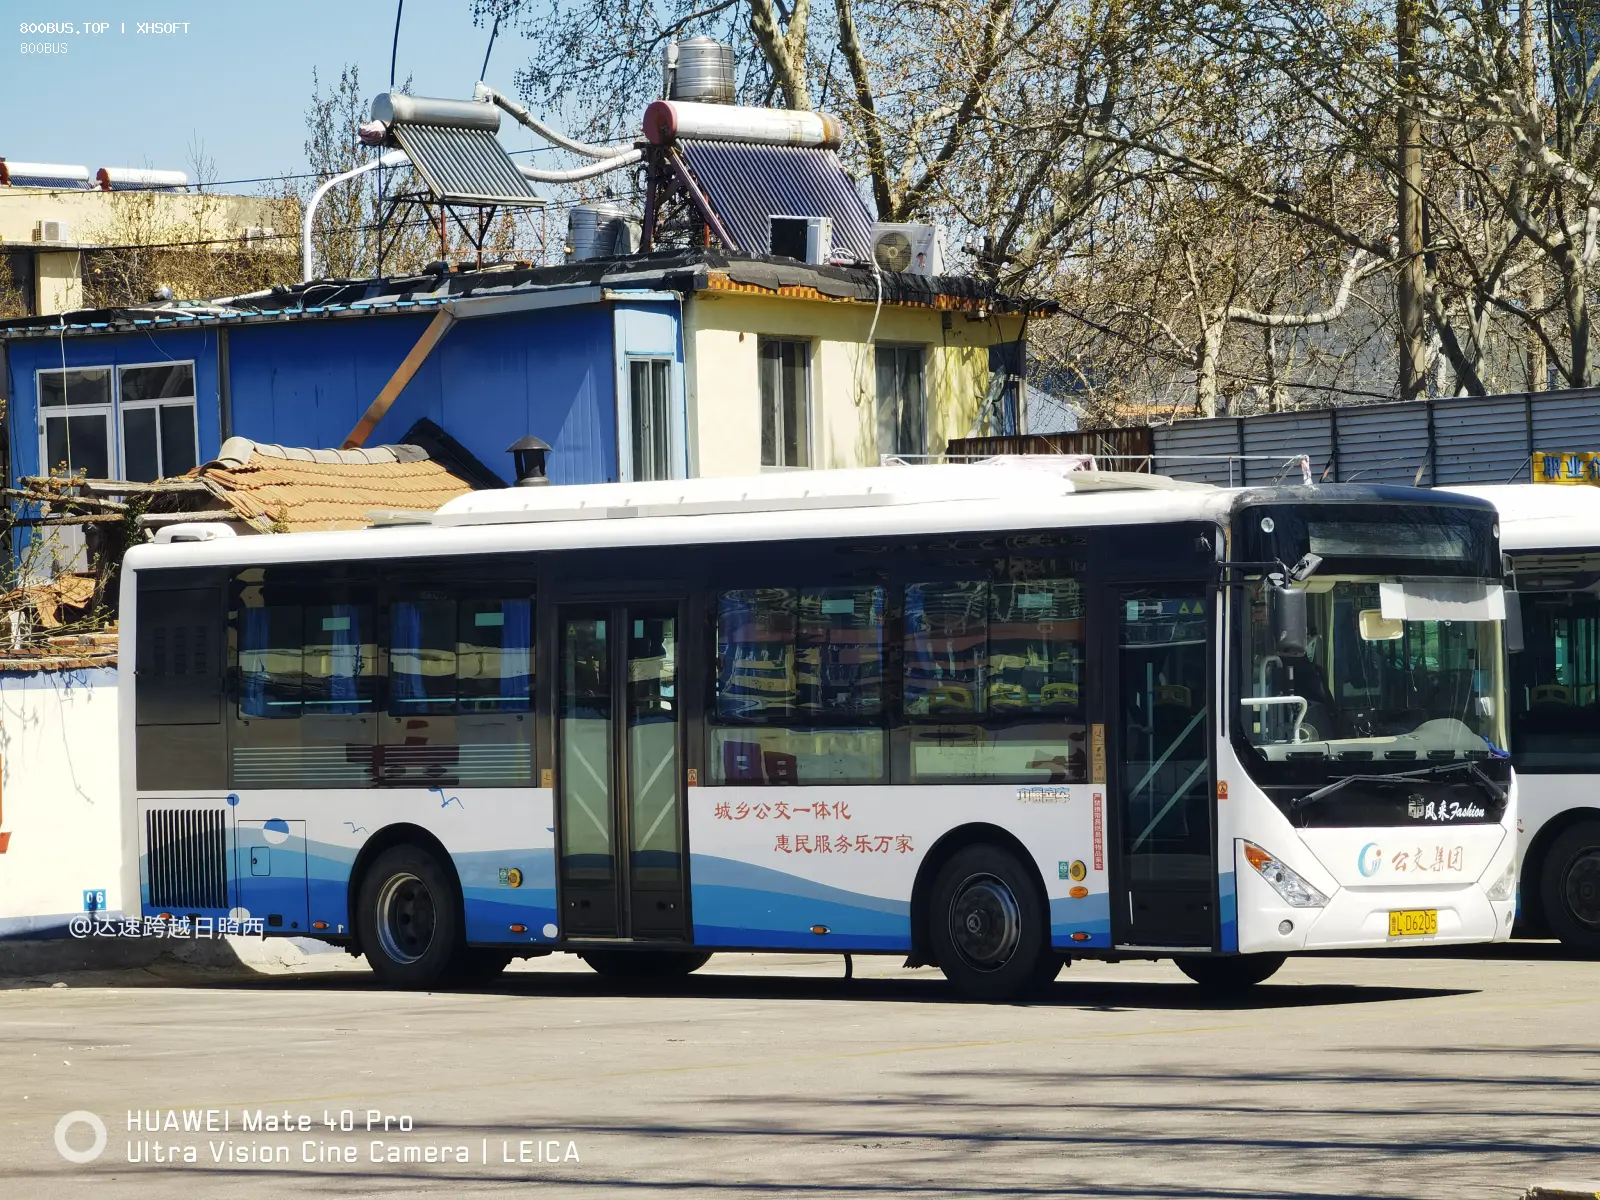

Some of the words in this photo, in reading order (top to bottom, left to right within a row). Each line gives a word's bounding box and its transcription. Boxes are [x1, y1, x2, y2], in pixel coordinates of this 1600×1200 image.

[714, 801, 852, 821] 城乡公交一体化
[1425, 800, 1450, 821] 风采
[1449, 802, 1485, 821] Fashion
[774, 833, 915, 855] 惠民服务乐万家
[1391, 845, 1464, 873] 公交集团
[86, 891, 104, 904] 06
